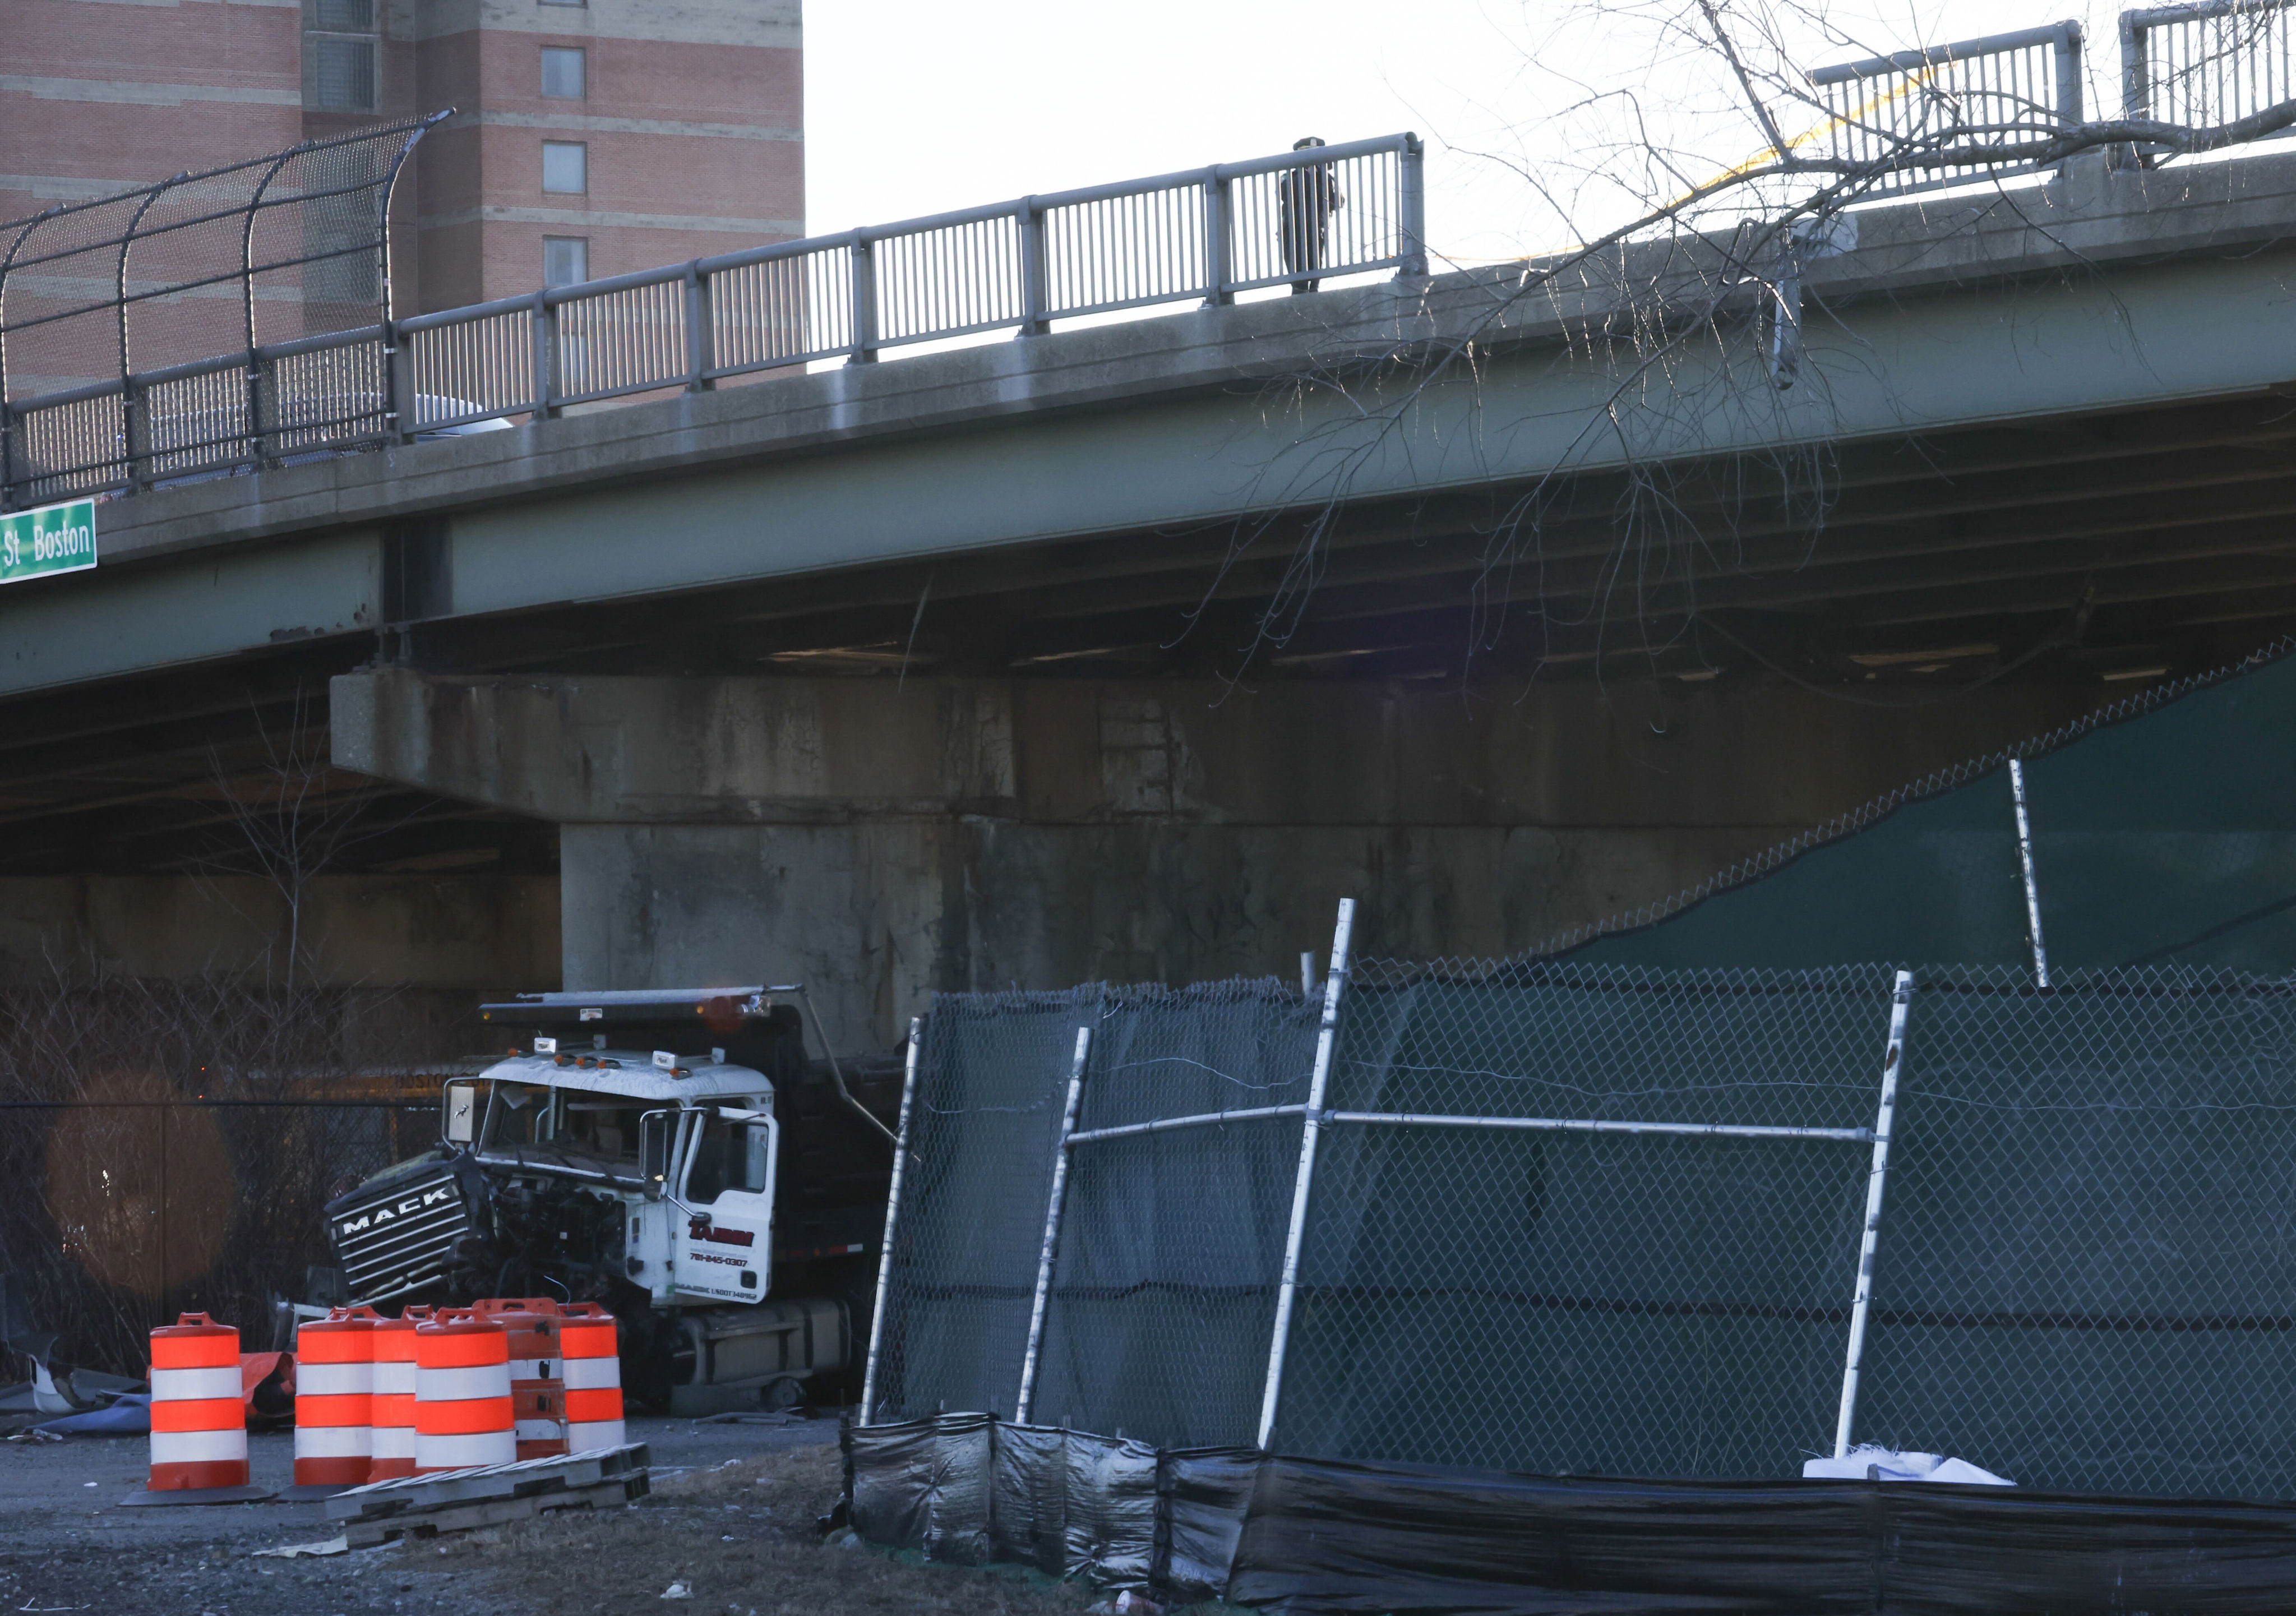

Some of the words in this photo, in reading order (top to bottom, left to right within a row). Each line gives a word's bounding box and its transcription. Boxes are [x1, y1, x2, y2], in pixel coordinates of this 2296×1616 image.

[4, 530, 21, 566] St
[34, 520, 90, 561] Boston
[343, 1188, 449, 1234] MACK
[690, 1253, 747, 1267] 781-245-0307
